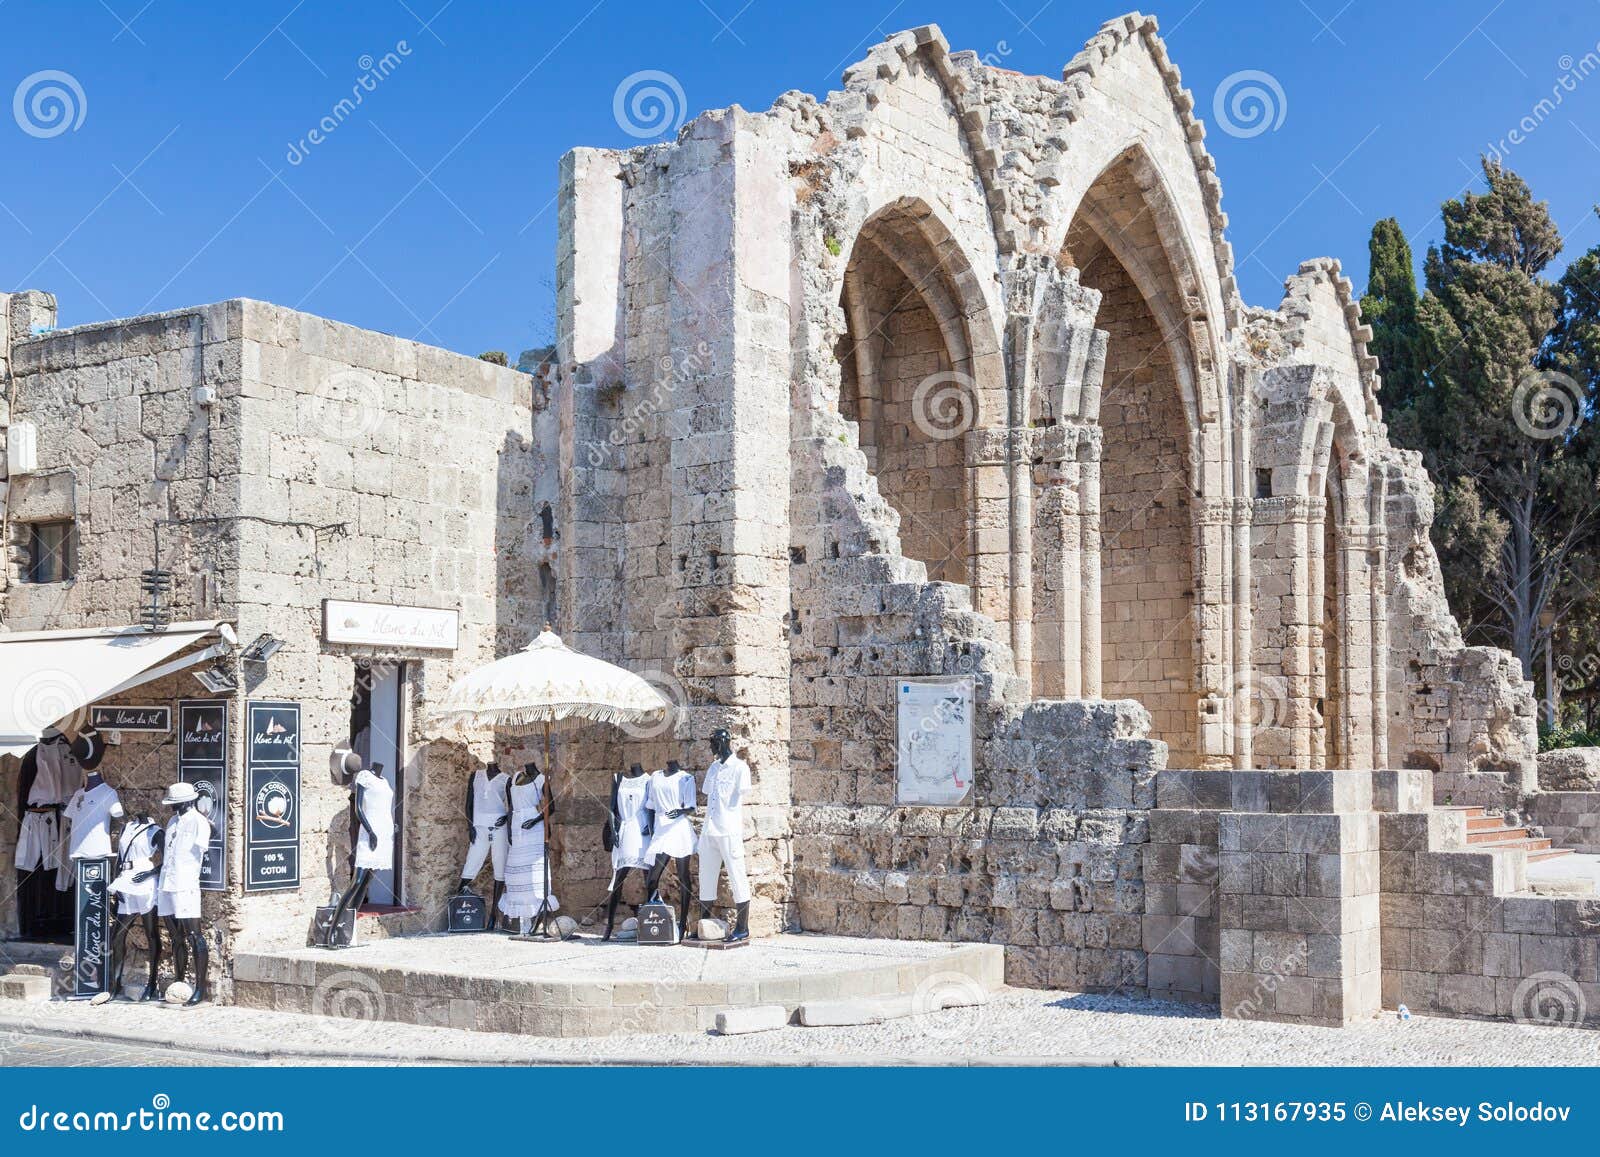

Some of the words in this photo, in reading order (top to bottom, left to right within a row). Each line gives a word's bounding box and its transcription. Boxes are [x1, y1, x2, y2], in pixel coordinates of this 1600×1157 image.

[263, 853, 276, 862] 100
[277, 853, 284, 861] %
[260, 866, 287, 875] COTON
